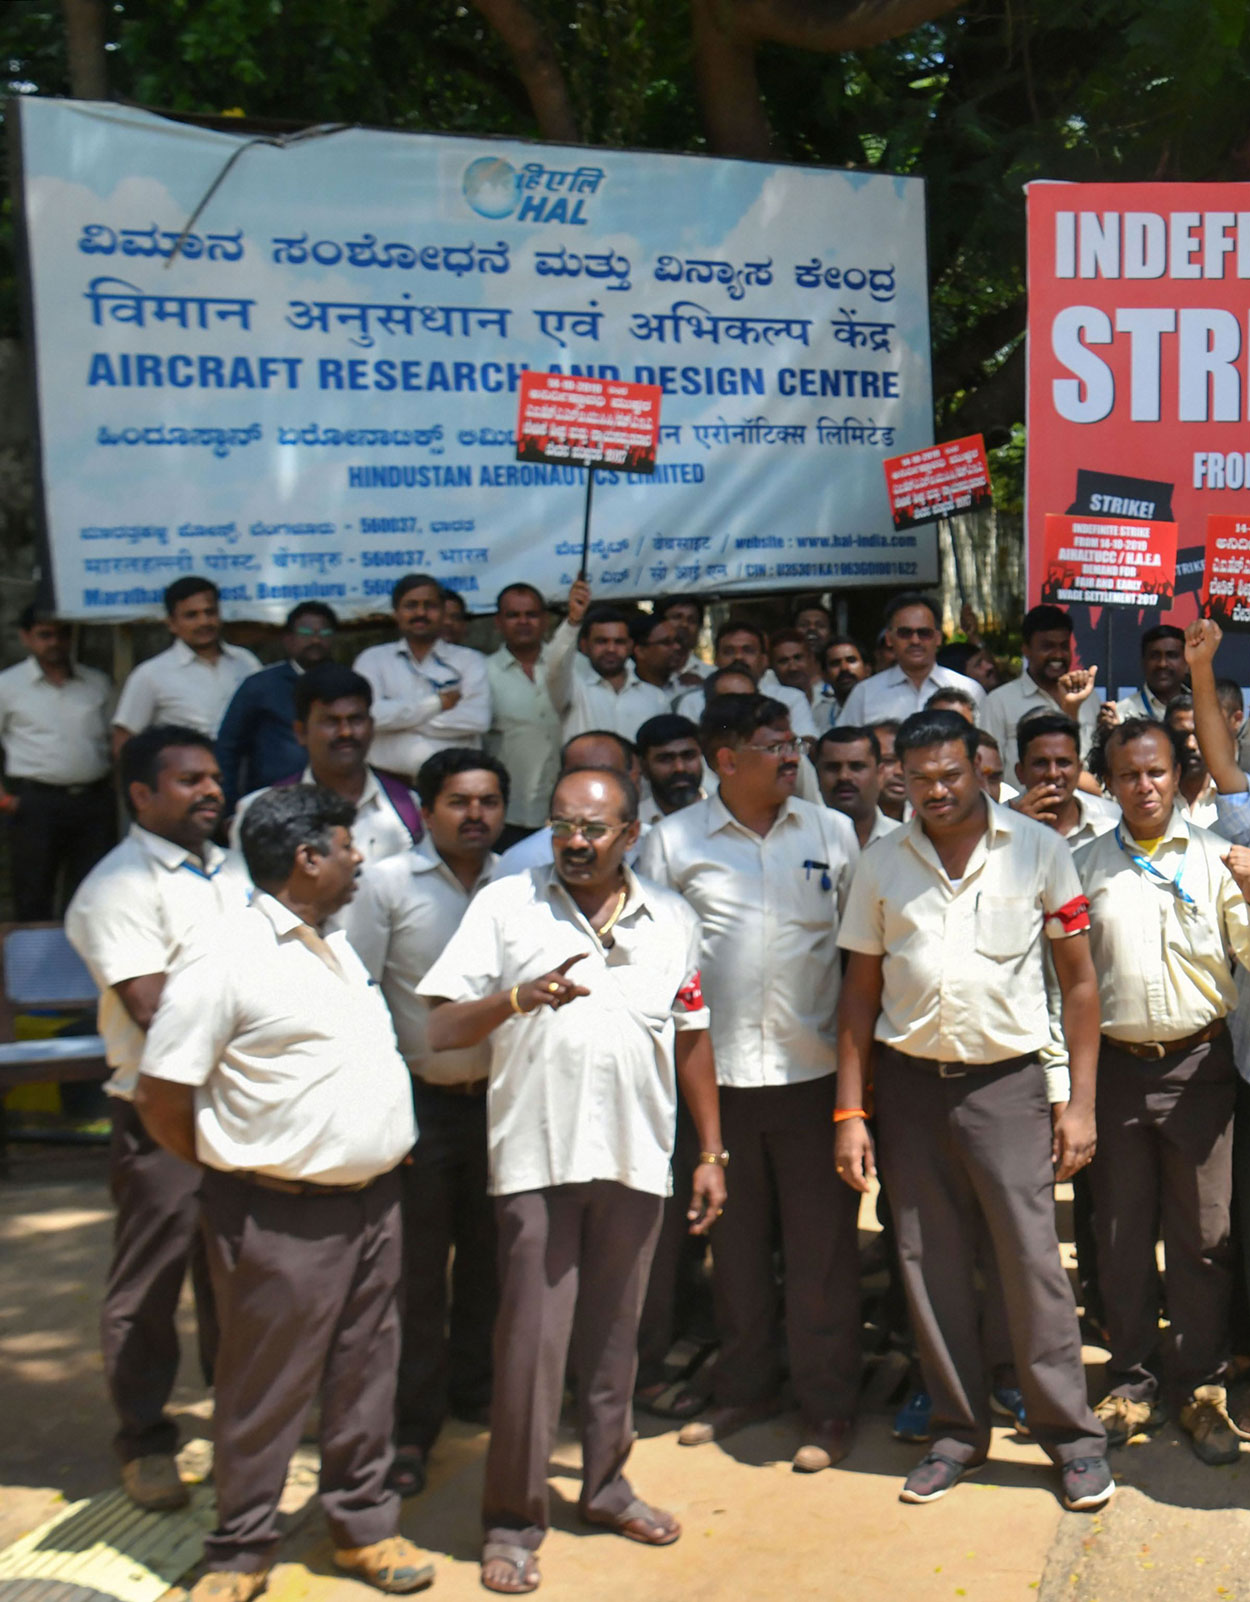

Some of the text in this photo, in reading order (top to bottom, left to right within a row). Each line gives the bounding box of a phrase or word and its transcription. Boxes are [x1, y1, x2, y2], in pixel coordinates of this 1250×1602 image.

[517, 196, 589, 225] HAL
[78, 224, 896, 302] ವಿಮಾನ ಸಂಶೋಧನೆ ಮತ್ತು ವಿನ್ಯಾಸ ಕೇಂದ್ರ
[83, 276, 895, 352] विमान अनुसंधान एवं अभिकल्प केंद्र
[87, 353, 304, 389] AIRCRAFT
[319, 357, 529, 392] RESEARCH
[636, 366, 765, 396] DESIGN
[779, 369, 900, 399] CENTRE
[693, 417, 806, 445] एरोनॉटिक्स
[817, 416, 895, 447] लिमिटेड
[349, 465, 472, 488] HINDUSTAN
[479, 464, 620, 487] AERONAUTCS
[1089, 493, 1155, 519] STRIKE!
[735, 534, 784, 548] website
[795, 533, 917, 548] www.hal-india.com
